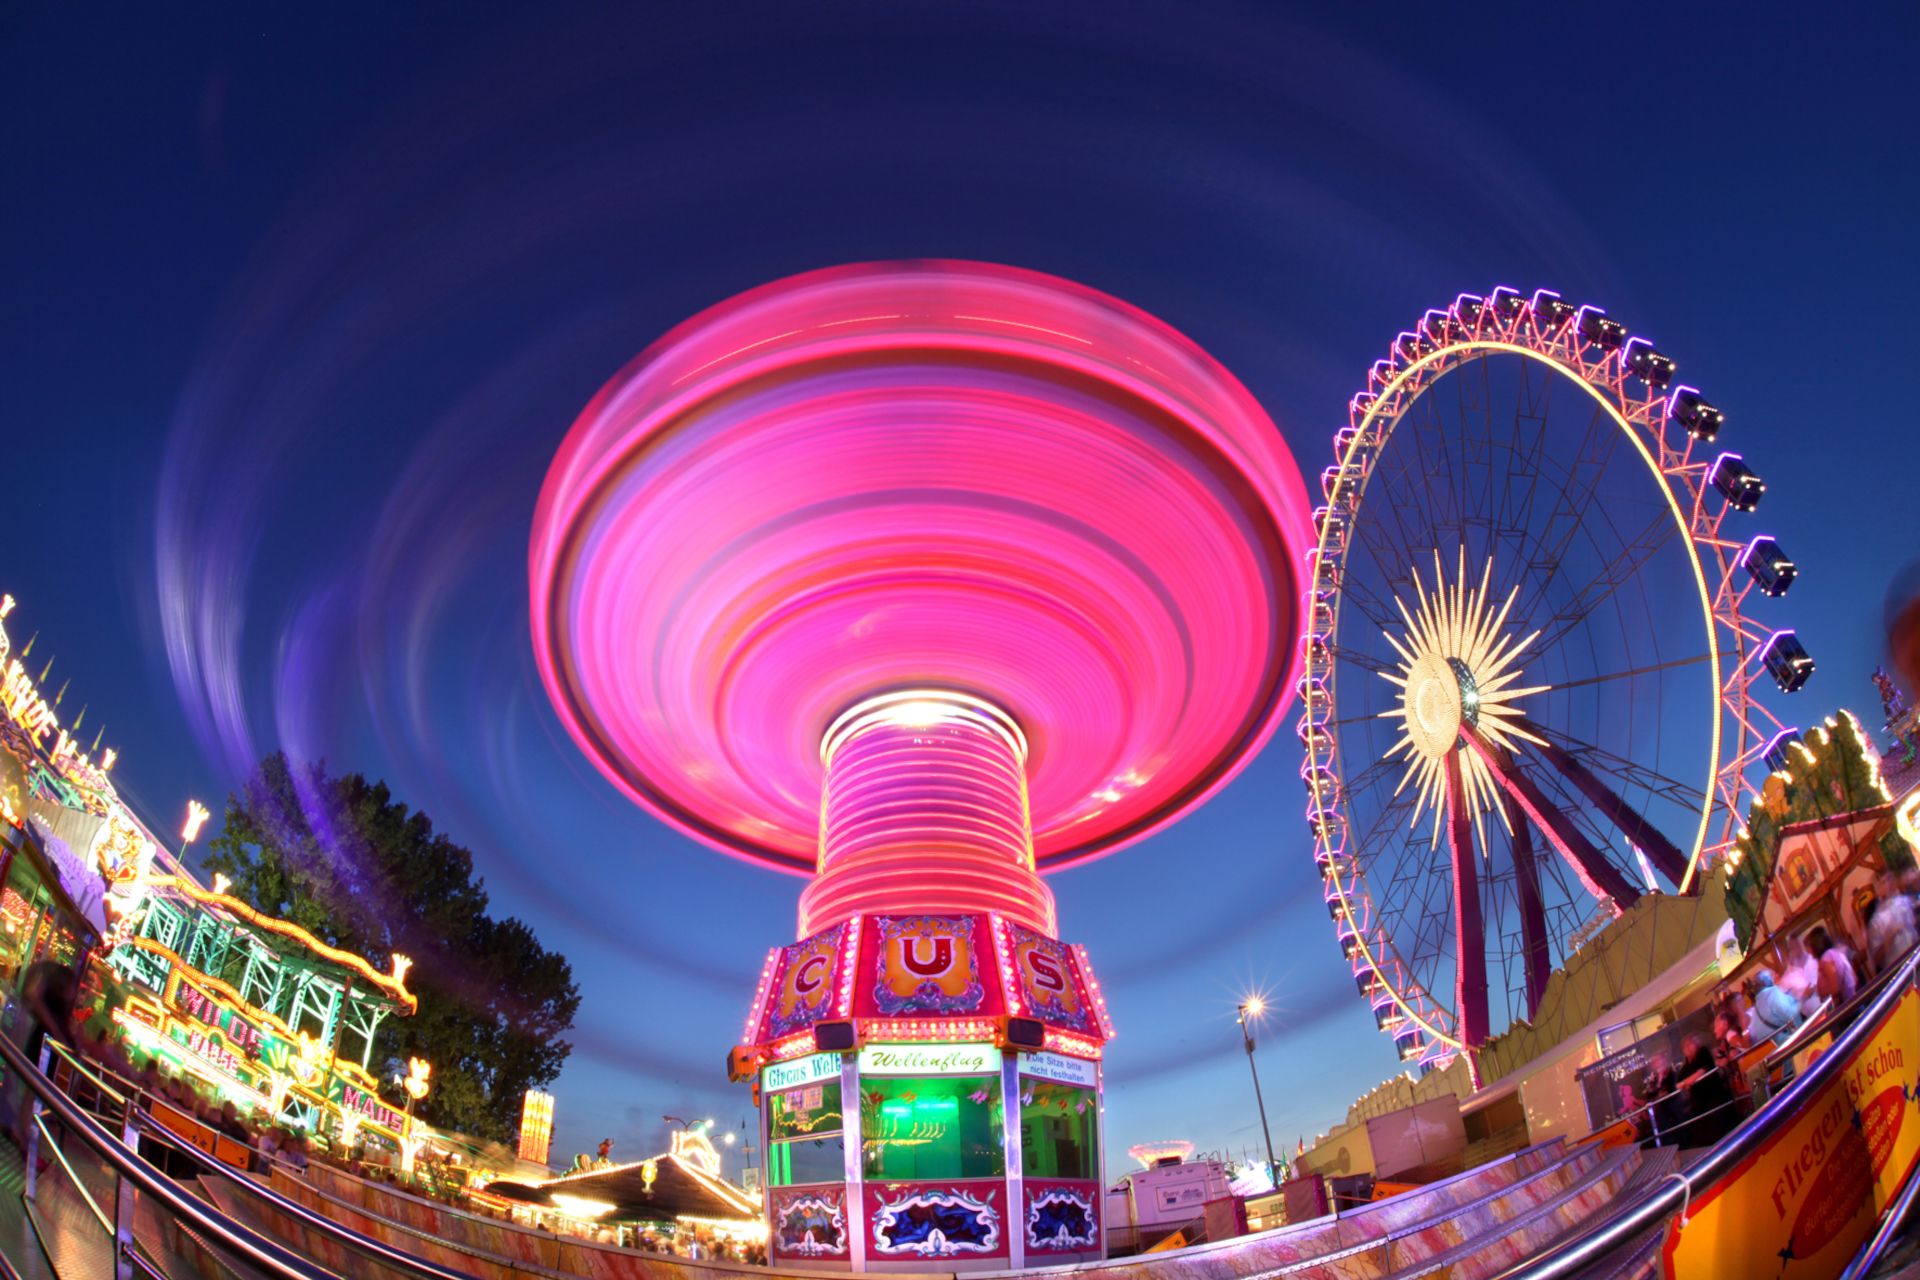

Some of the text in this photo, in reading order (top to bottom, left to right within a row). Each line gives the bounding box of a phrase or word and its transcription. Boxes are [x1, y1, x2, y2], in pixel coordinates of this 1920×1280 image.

[795, 937, 1064, 993] C U S
[182, 983, 404, 1133] WILDE MAUS
[768, 1053, 842, 1087] Circus Welt
[871, 1052, 985, 1071] Wellenflug
[1030, 1065, 1085, 1082] nicht festhalten
[1032, 1053, 1082, 1071] Die Sitze bitte
[1771, 1103, 1844, 1221] Fliegen
[1843, 1067, 1865, 1107] ist
[1866, 1042, 1905, 1085] schön
